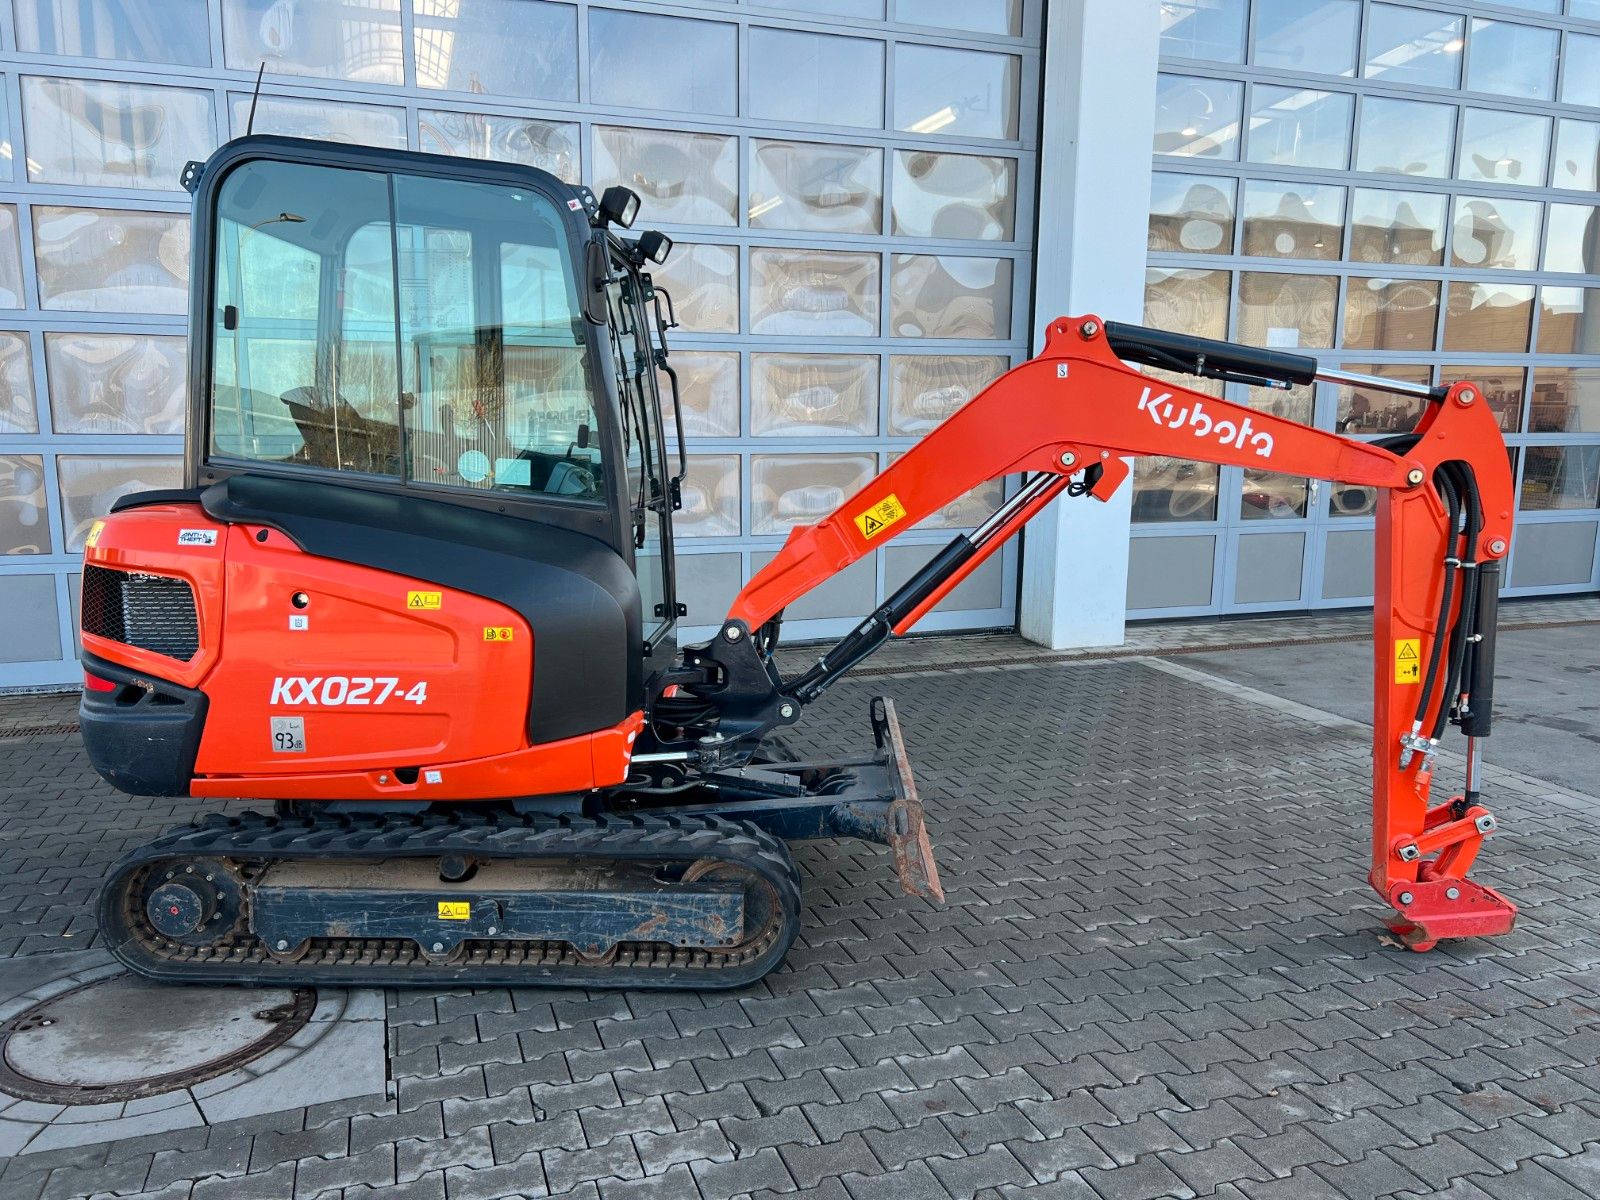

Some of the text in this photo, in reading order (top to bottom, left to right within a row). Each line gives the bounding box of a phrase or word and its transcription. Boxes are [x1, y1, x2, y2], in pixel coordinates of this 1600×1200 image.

[1137, 386, 1274, 458] Kubota
[269, 676, 428, 706] KX027-4
[275, 732, 294, 749] 93
